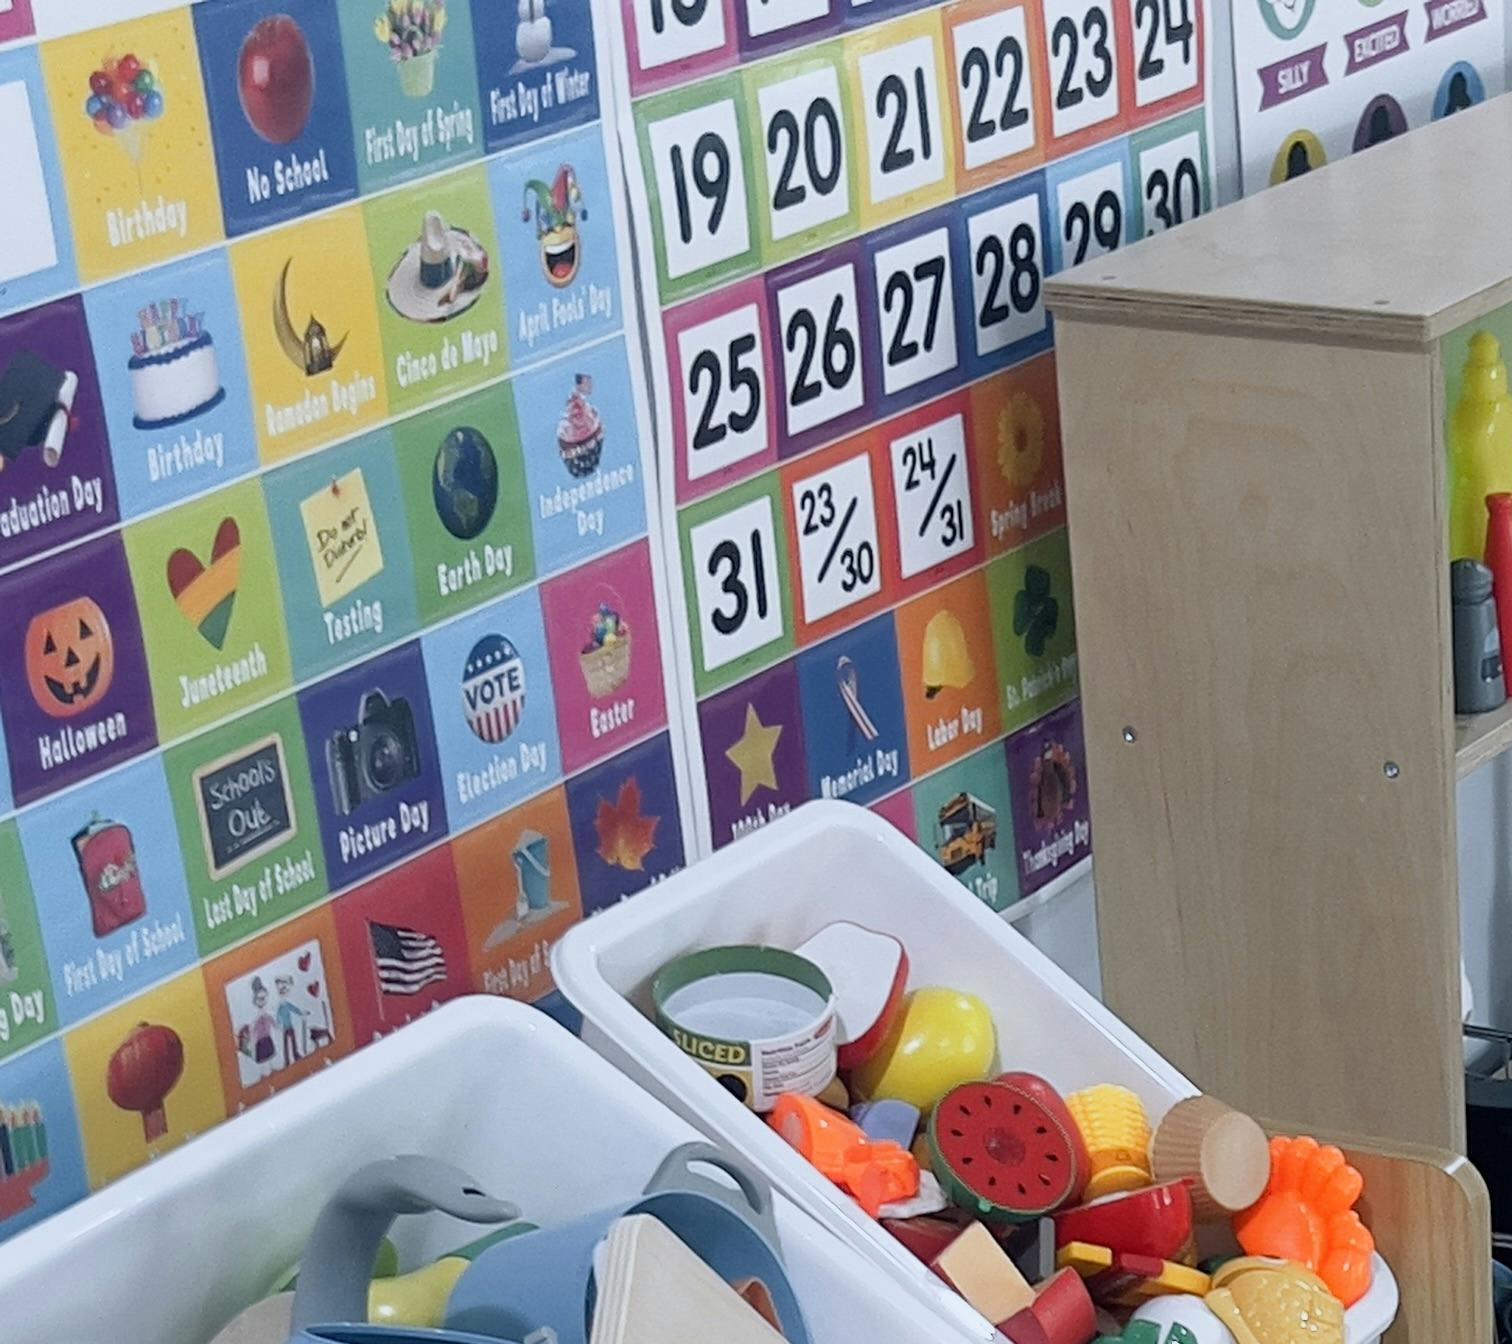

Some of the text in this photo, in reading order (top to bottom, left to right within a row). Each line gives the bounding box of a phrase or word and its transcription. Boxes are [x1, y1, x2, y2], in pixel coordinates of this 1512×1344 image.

[1052, 6, 1113, 110] 23
[1135, 0, 1193, 81] 24
[490, 66, 591, 126] First Day of Winter
[961, 35, 1029, 144] 22
[1277, 60, 1311, 94] SILLY
[365, 101, 474, 166] First Day of Spring
[877, 66, 931, 174] 21
[246, 149, 330, 203] No School
[767, 97, 841, 211] 20
[670, 132, 730, 244] 19
[1146, 158, 1200, 236] 30
[105, 195, 188, 247] Birthday
[1065, 190, 1121, 266] 29
[976, 222, 1039, 329] 28
[518, 299, 550, 347] April
[588, 283, 613, 318] Day
[884, 255, 945, 366] 27
[396, 328, 498, 389] Cinco de Mayo
[786, 294, 856, 406] 26
[688, 333, 760, 449] 25
[147, 430, 224, 482] Birthday
[71, 474, 103, 513] Day
[540, 463, 635, 519] Independence
[989, 482, 1062, 541] Spring Break
[576, 508, 604, 537] Day
[437, 544, 513, 596] Earth Day
[709, 529, 768, 635] 31
[323, 600, 383, 645] Testing
[178, 641, 268, 708] Juneteenth
[464, 666, 521, 712] VOTE
[38, 712, 128, 771] Halloween
[589, 699, 636, 738] Easter
[926, 705, 983, 751] Labor Day
[209, 757, 276, 812] School's
[456, 742, 548, 804] Election Day
[820, 749, 899, 801] Memorial Day
[226, 799, 273, 838] Out
[338, 800, 430, 864] Picture Day
[1022, 818, 1090, 876] Thanksgiving Day
[202, 850, 316, 931] Last Day of School
[974, 872, 998, 903] Trip
[63, 911, 186, 998] First Day of School
[507, 957, 530, 988] Day
[529, 942, 541, 976] of
[10, 989, 45, 1026] Day
[673, 1028, 746, 1066] SLICED
